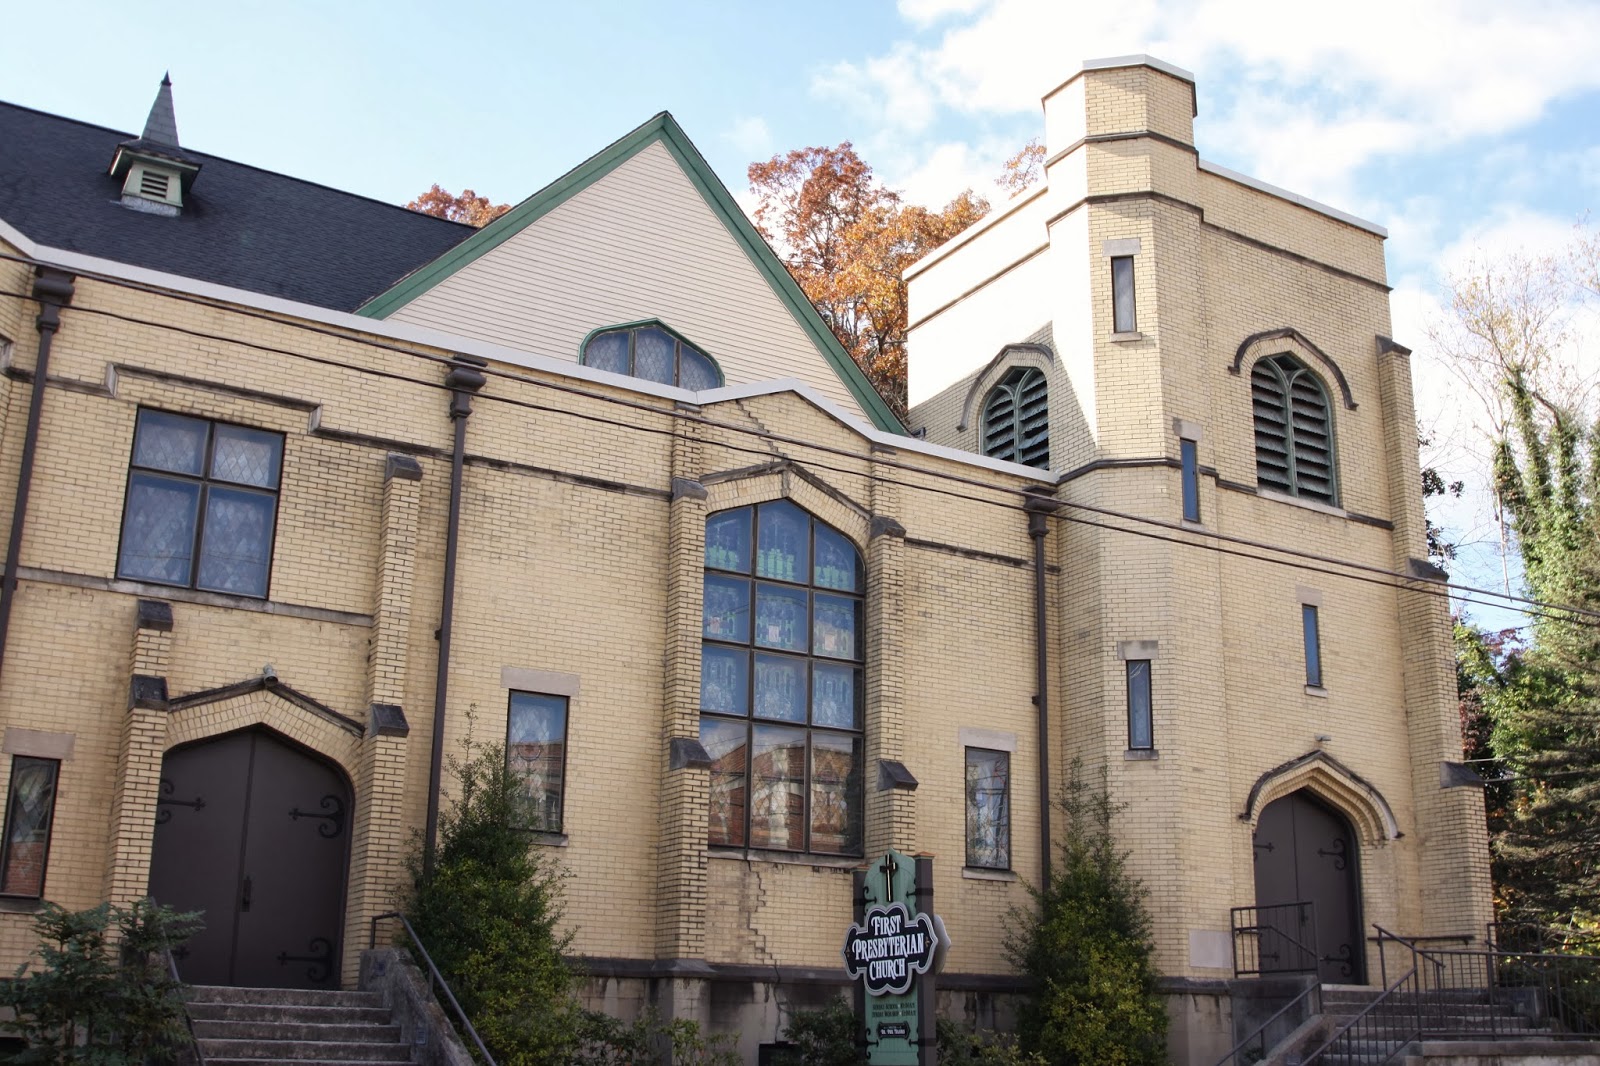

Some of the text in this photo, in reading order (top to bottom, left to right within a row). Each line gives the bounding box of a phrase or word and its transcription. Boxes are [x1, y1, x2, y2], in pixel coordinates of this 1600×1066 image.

[871, 915, 902, 936] FIRST
[852, 933, 924, 962] PRESBYTERIAN
[869, 958, 906, 980] CHURCH
